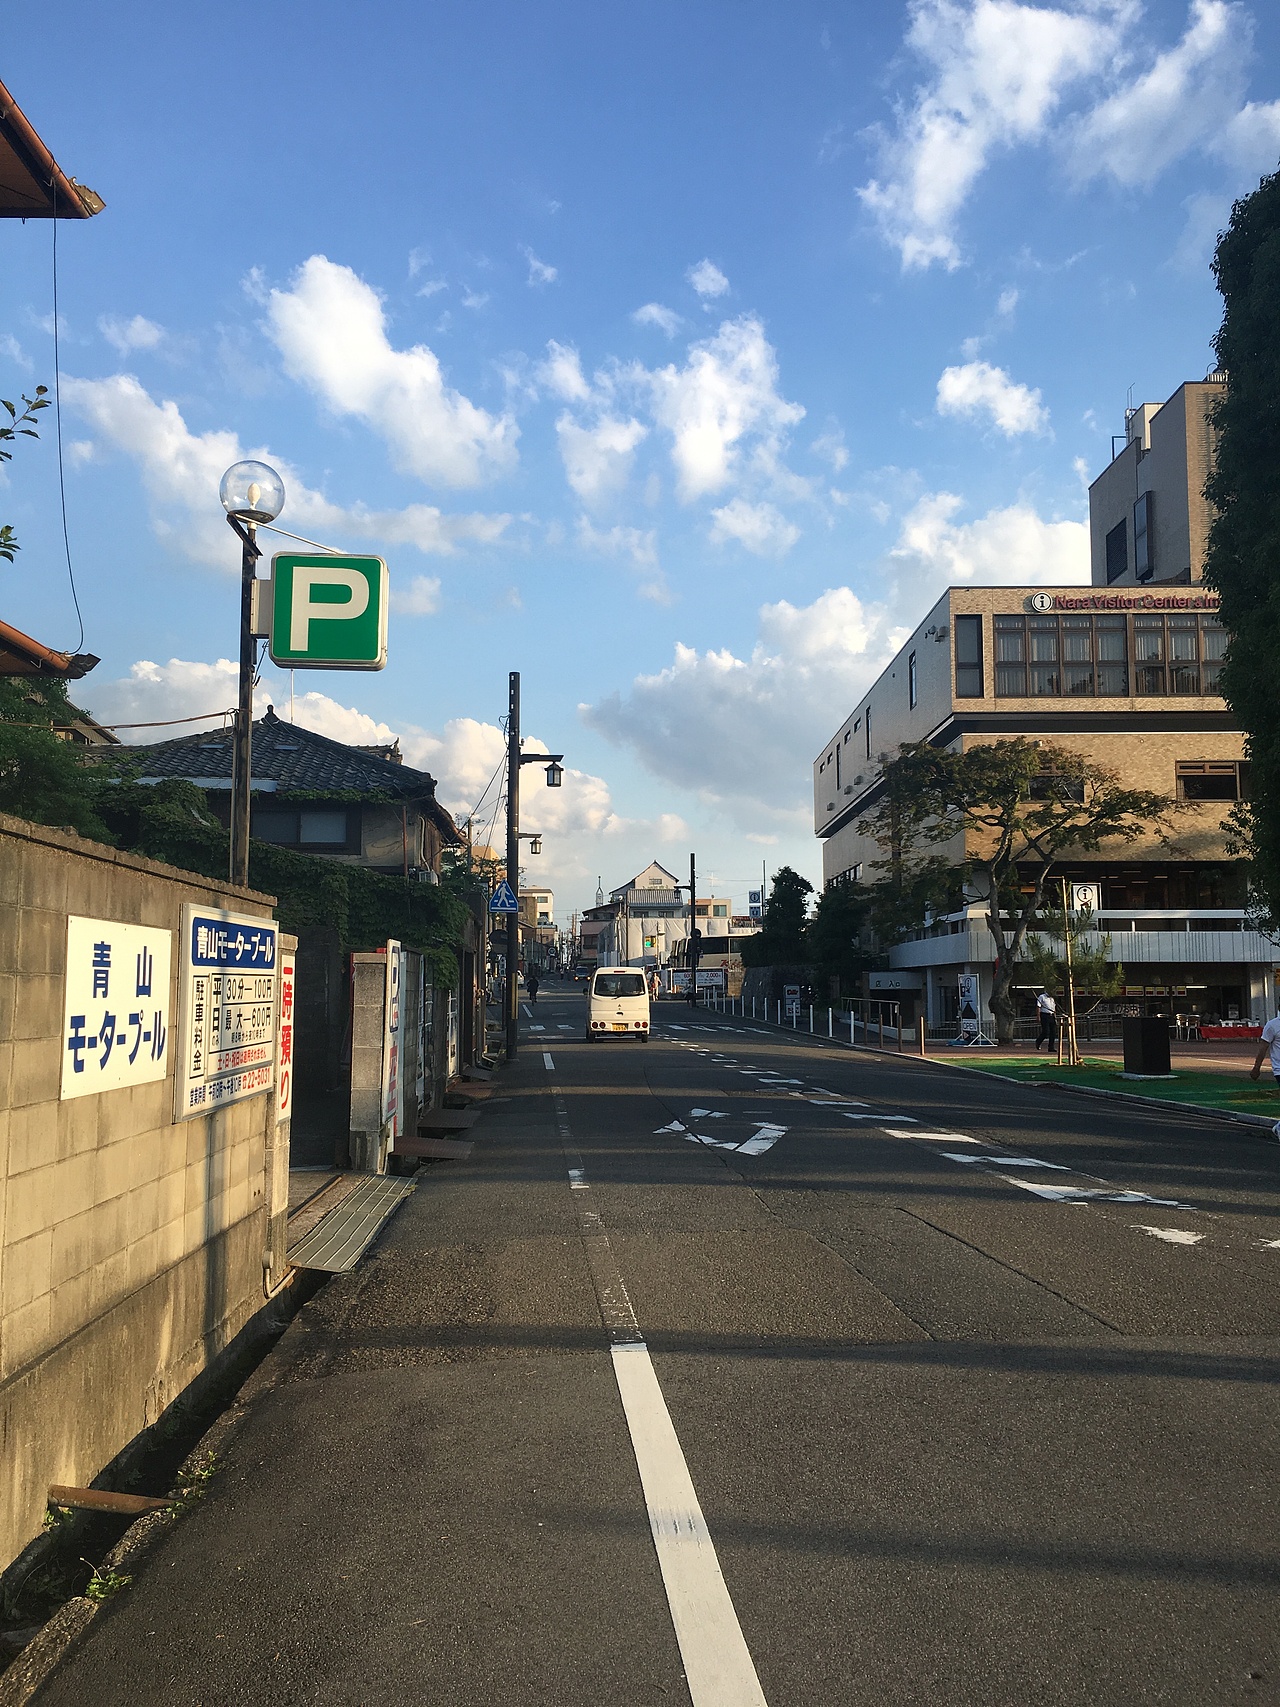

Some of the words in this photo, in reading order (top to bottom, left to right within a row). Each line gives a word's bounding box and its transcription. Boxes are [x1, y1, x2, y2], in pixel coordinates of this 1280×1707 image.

[290, 566, 370, 653] P
[1055, 595, 1091, 609] Nara
[1092, 594, 1139, 609] Visitor
[1143, 594, 1191, 608] Center
[1195, 599, 1203, 607] &
[92, 940, 153, 999] 青山
[196, 926, 274, 963] 青山モータープール
[193, 980, 205, 1072] 駐車料金
[212, 977, 222, 1033] 平日
[68, 1010, 166, 1073] モータープール
[280, 966, 294, 1110] 一時預り
